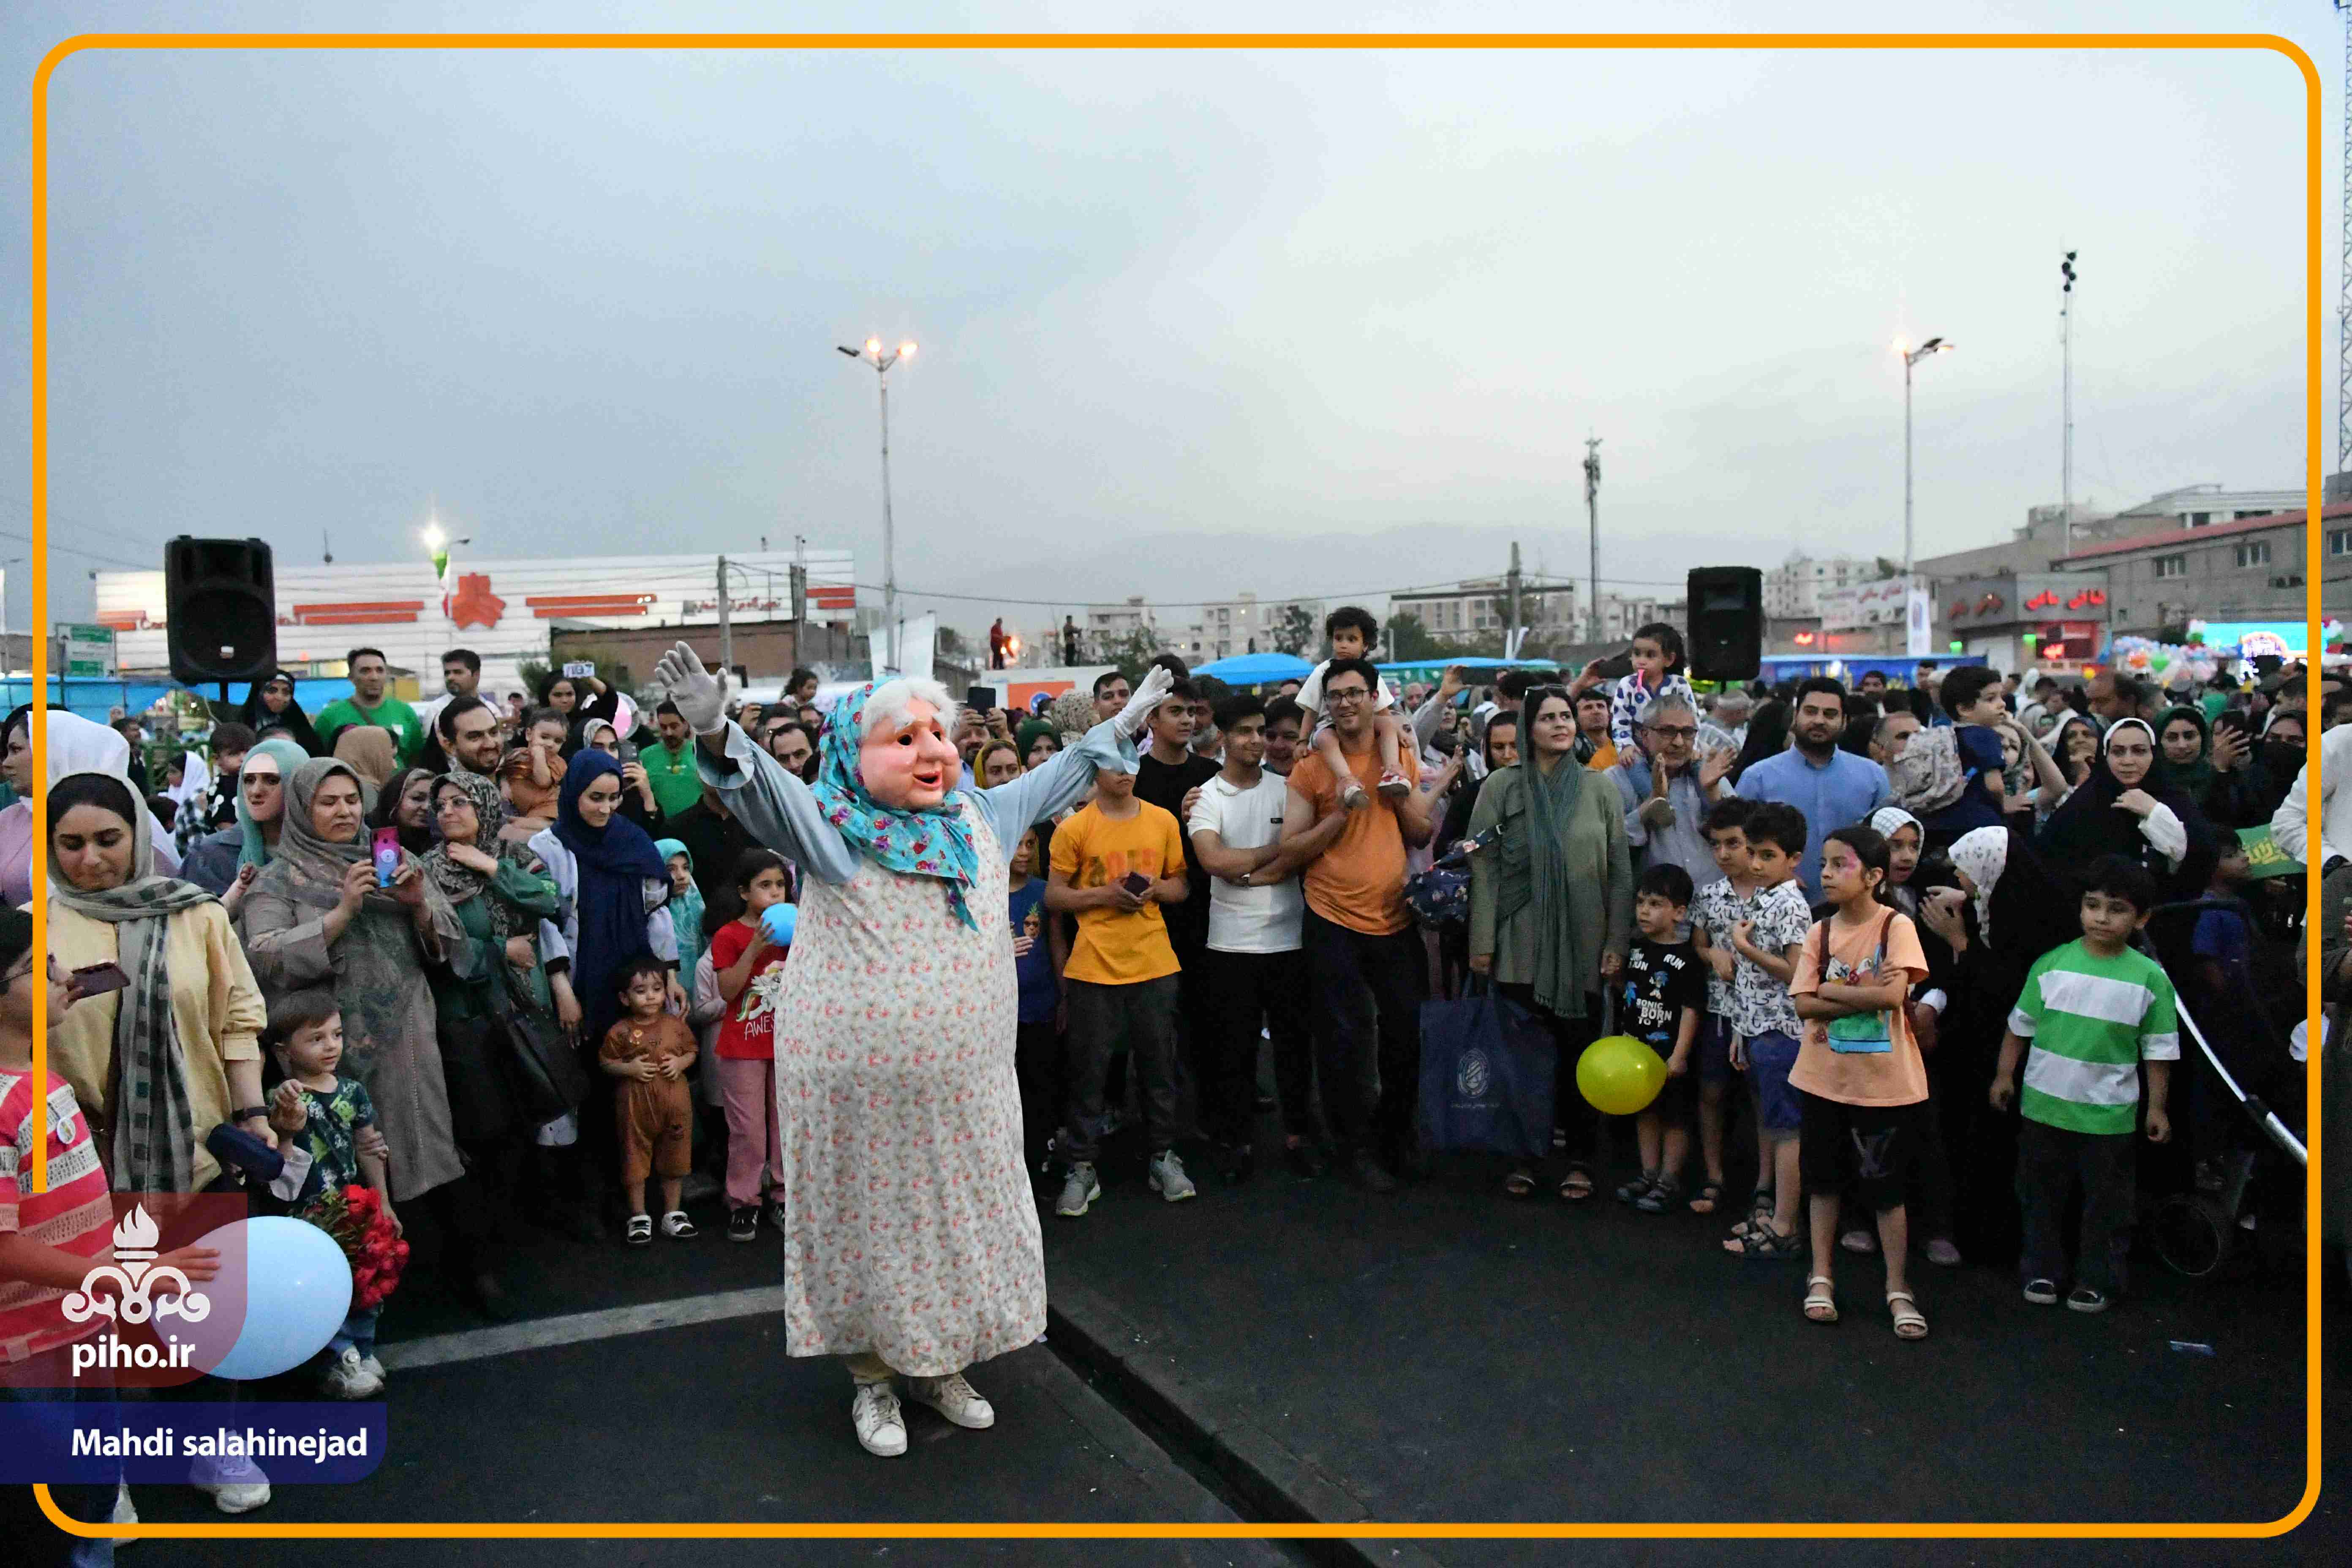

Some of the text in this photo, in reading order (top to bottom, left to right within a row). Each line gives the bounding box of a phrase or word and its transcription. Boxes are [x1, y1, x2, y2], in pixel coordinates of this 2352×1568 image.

[1663, 953, 1686, 970] RUN
[1636, 998, 1663, 1010] SONIC
[1641, 1006, 1672, 1021] BORN
[1638, 1016, 1651, 1026] TO
